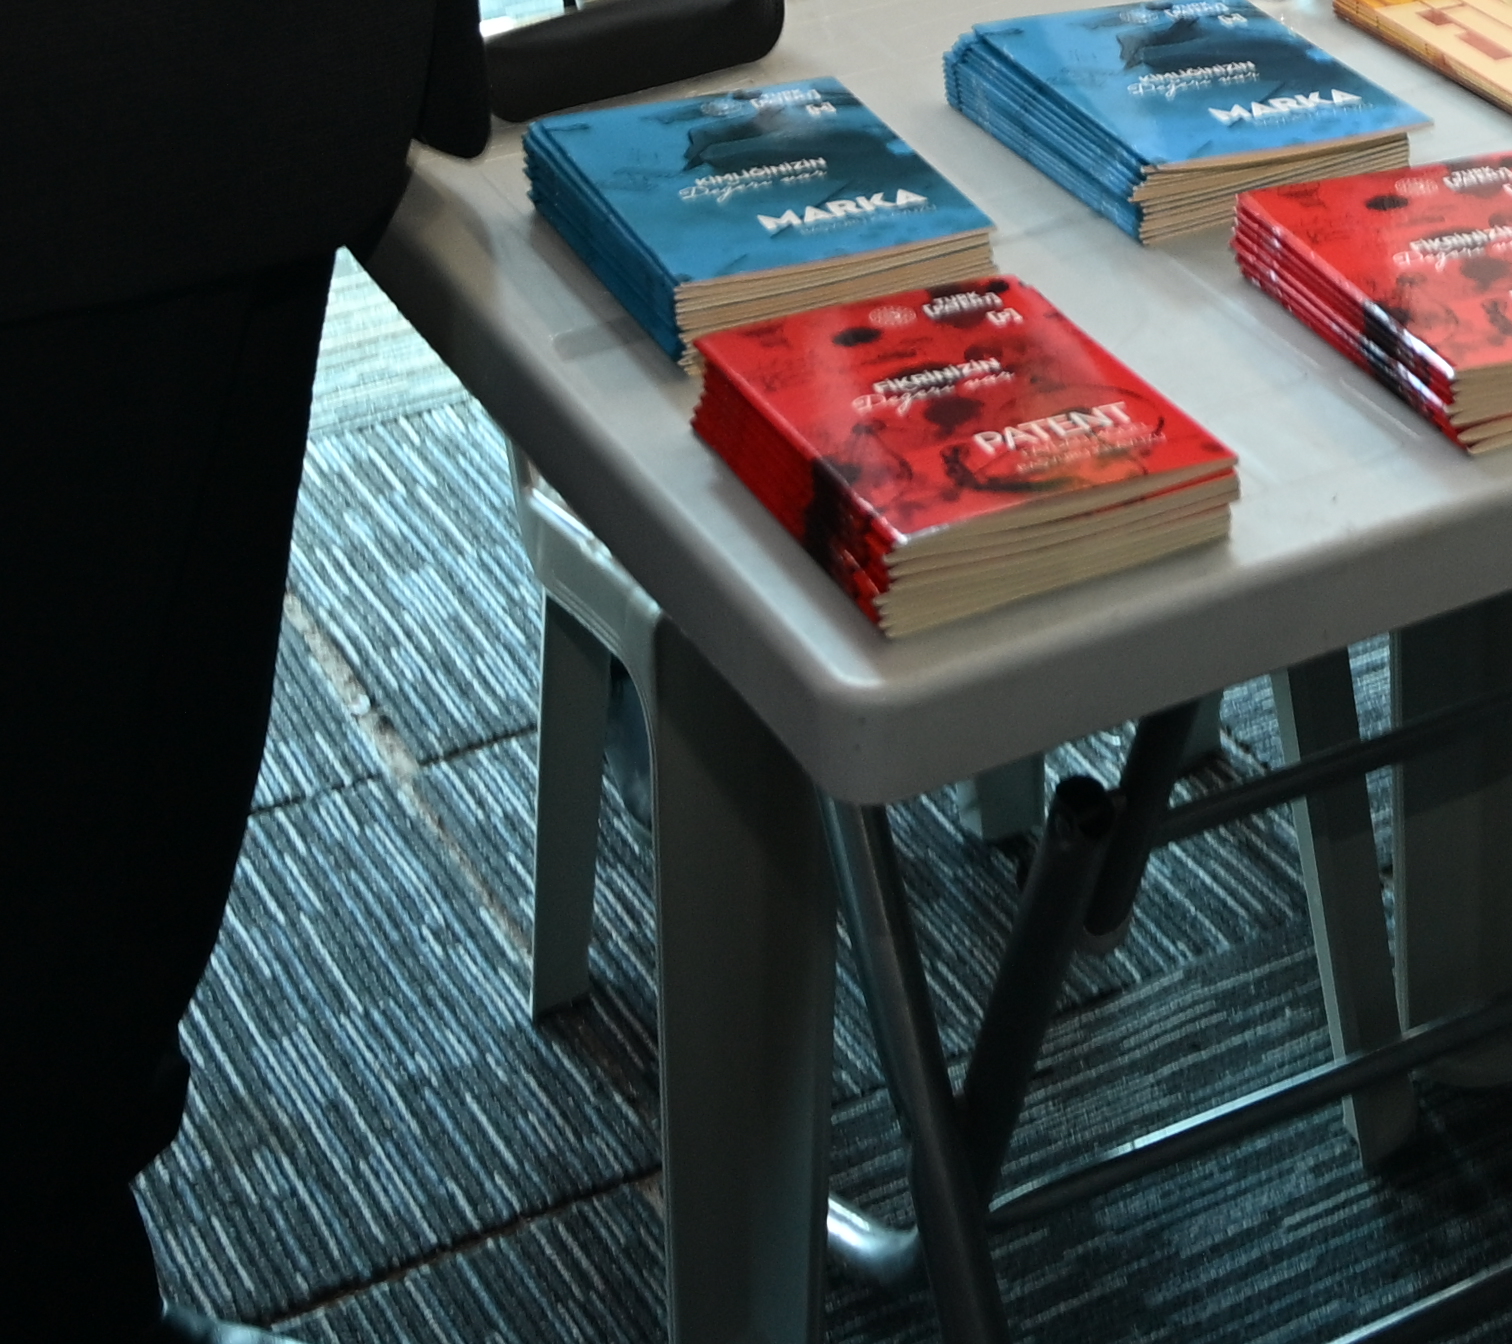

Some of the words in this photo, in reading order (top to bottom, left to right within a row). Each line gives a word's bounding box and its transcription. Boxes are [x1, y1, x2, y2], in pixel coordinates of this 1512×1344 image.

[1208, 88, 1362, 127] MARKA
[757, 188, 928, 232] MARKA
[973, 400, 1131, 454] PATENT
